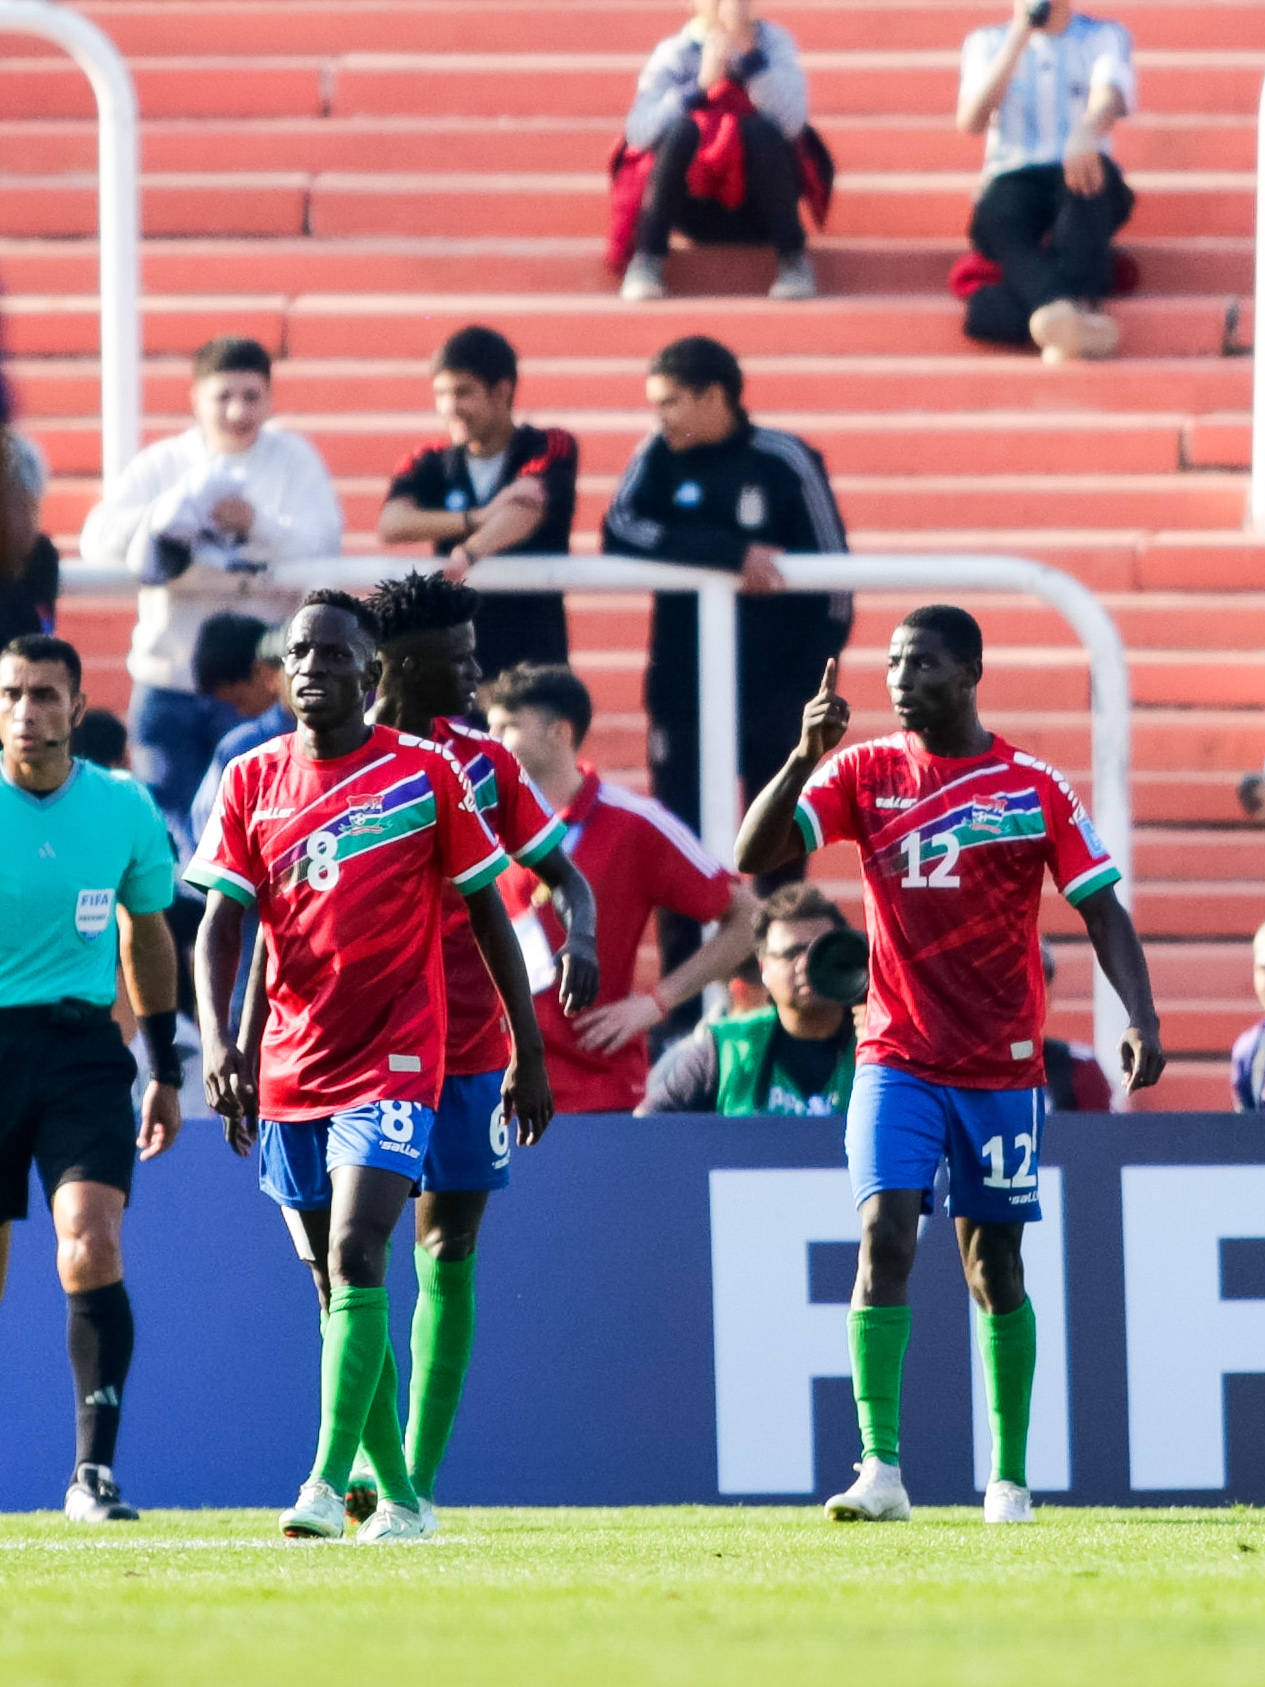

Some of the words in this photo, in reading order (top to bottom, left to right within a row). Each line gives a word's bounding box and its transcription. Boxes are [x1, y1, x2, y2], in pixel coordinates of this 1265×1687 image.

[306, 830, 340, 891] 8
[900, 832, 961, 888] 12
[80, 893, 109, 906] FIFA
[379, 1099, 414, 1143] 8
[489, 1102, 509, 1156] 6
[981, 1132, 1037, 1189] 12
